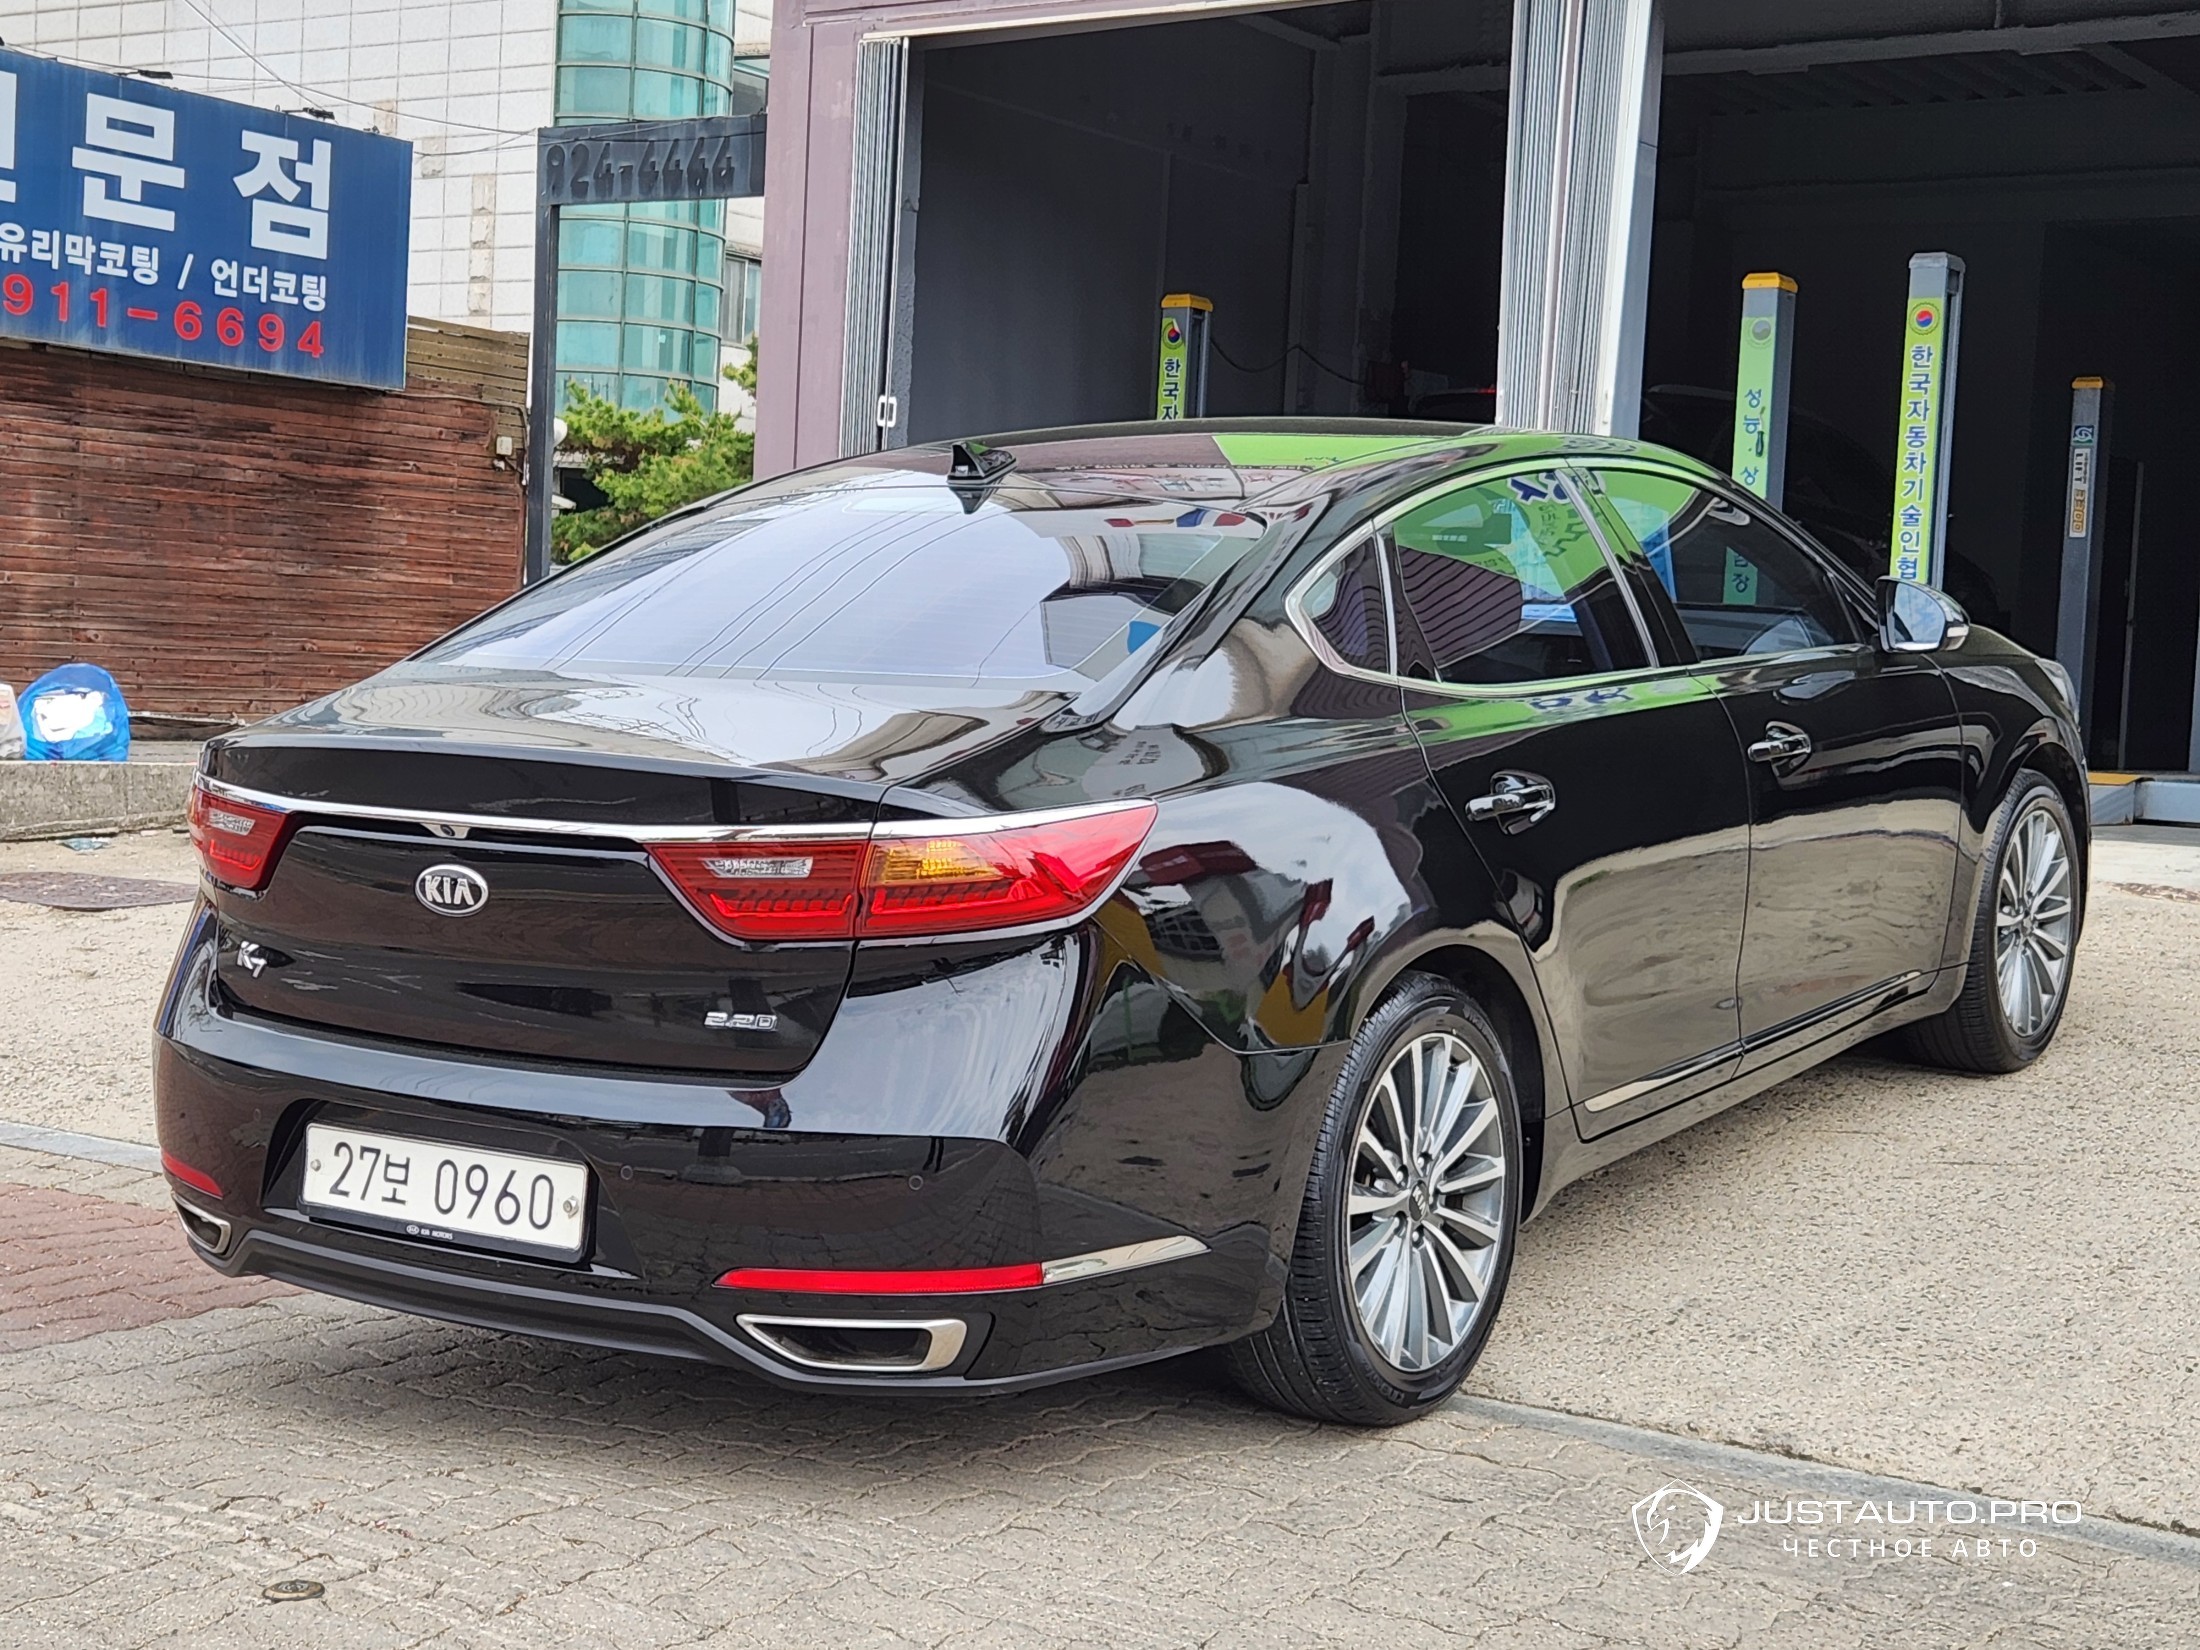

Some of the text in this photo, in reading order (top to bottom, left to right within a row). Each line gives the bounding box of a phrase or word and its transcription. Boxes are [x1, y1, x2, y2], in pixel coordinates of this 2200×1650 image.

[0, 70, 332, 260] 문점
[0, 222, 159, 285] 유리막코팅
[210, 258, 327, 312] 언더코팅
[2, 273, 325, 358] 911-6694
[1161, 358, 1182, 420] 한국자
[1897, 345, 1933, 580] 한국자동차기술인협
[425, 875, 475, 906] KIA
[236, 940, 268, 978] K7
[329, 1141, 555, 1230] 27보 0960
